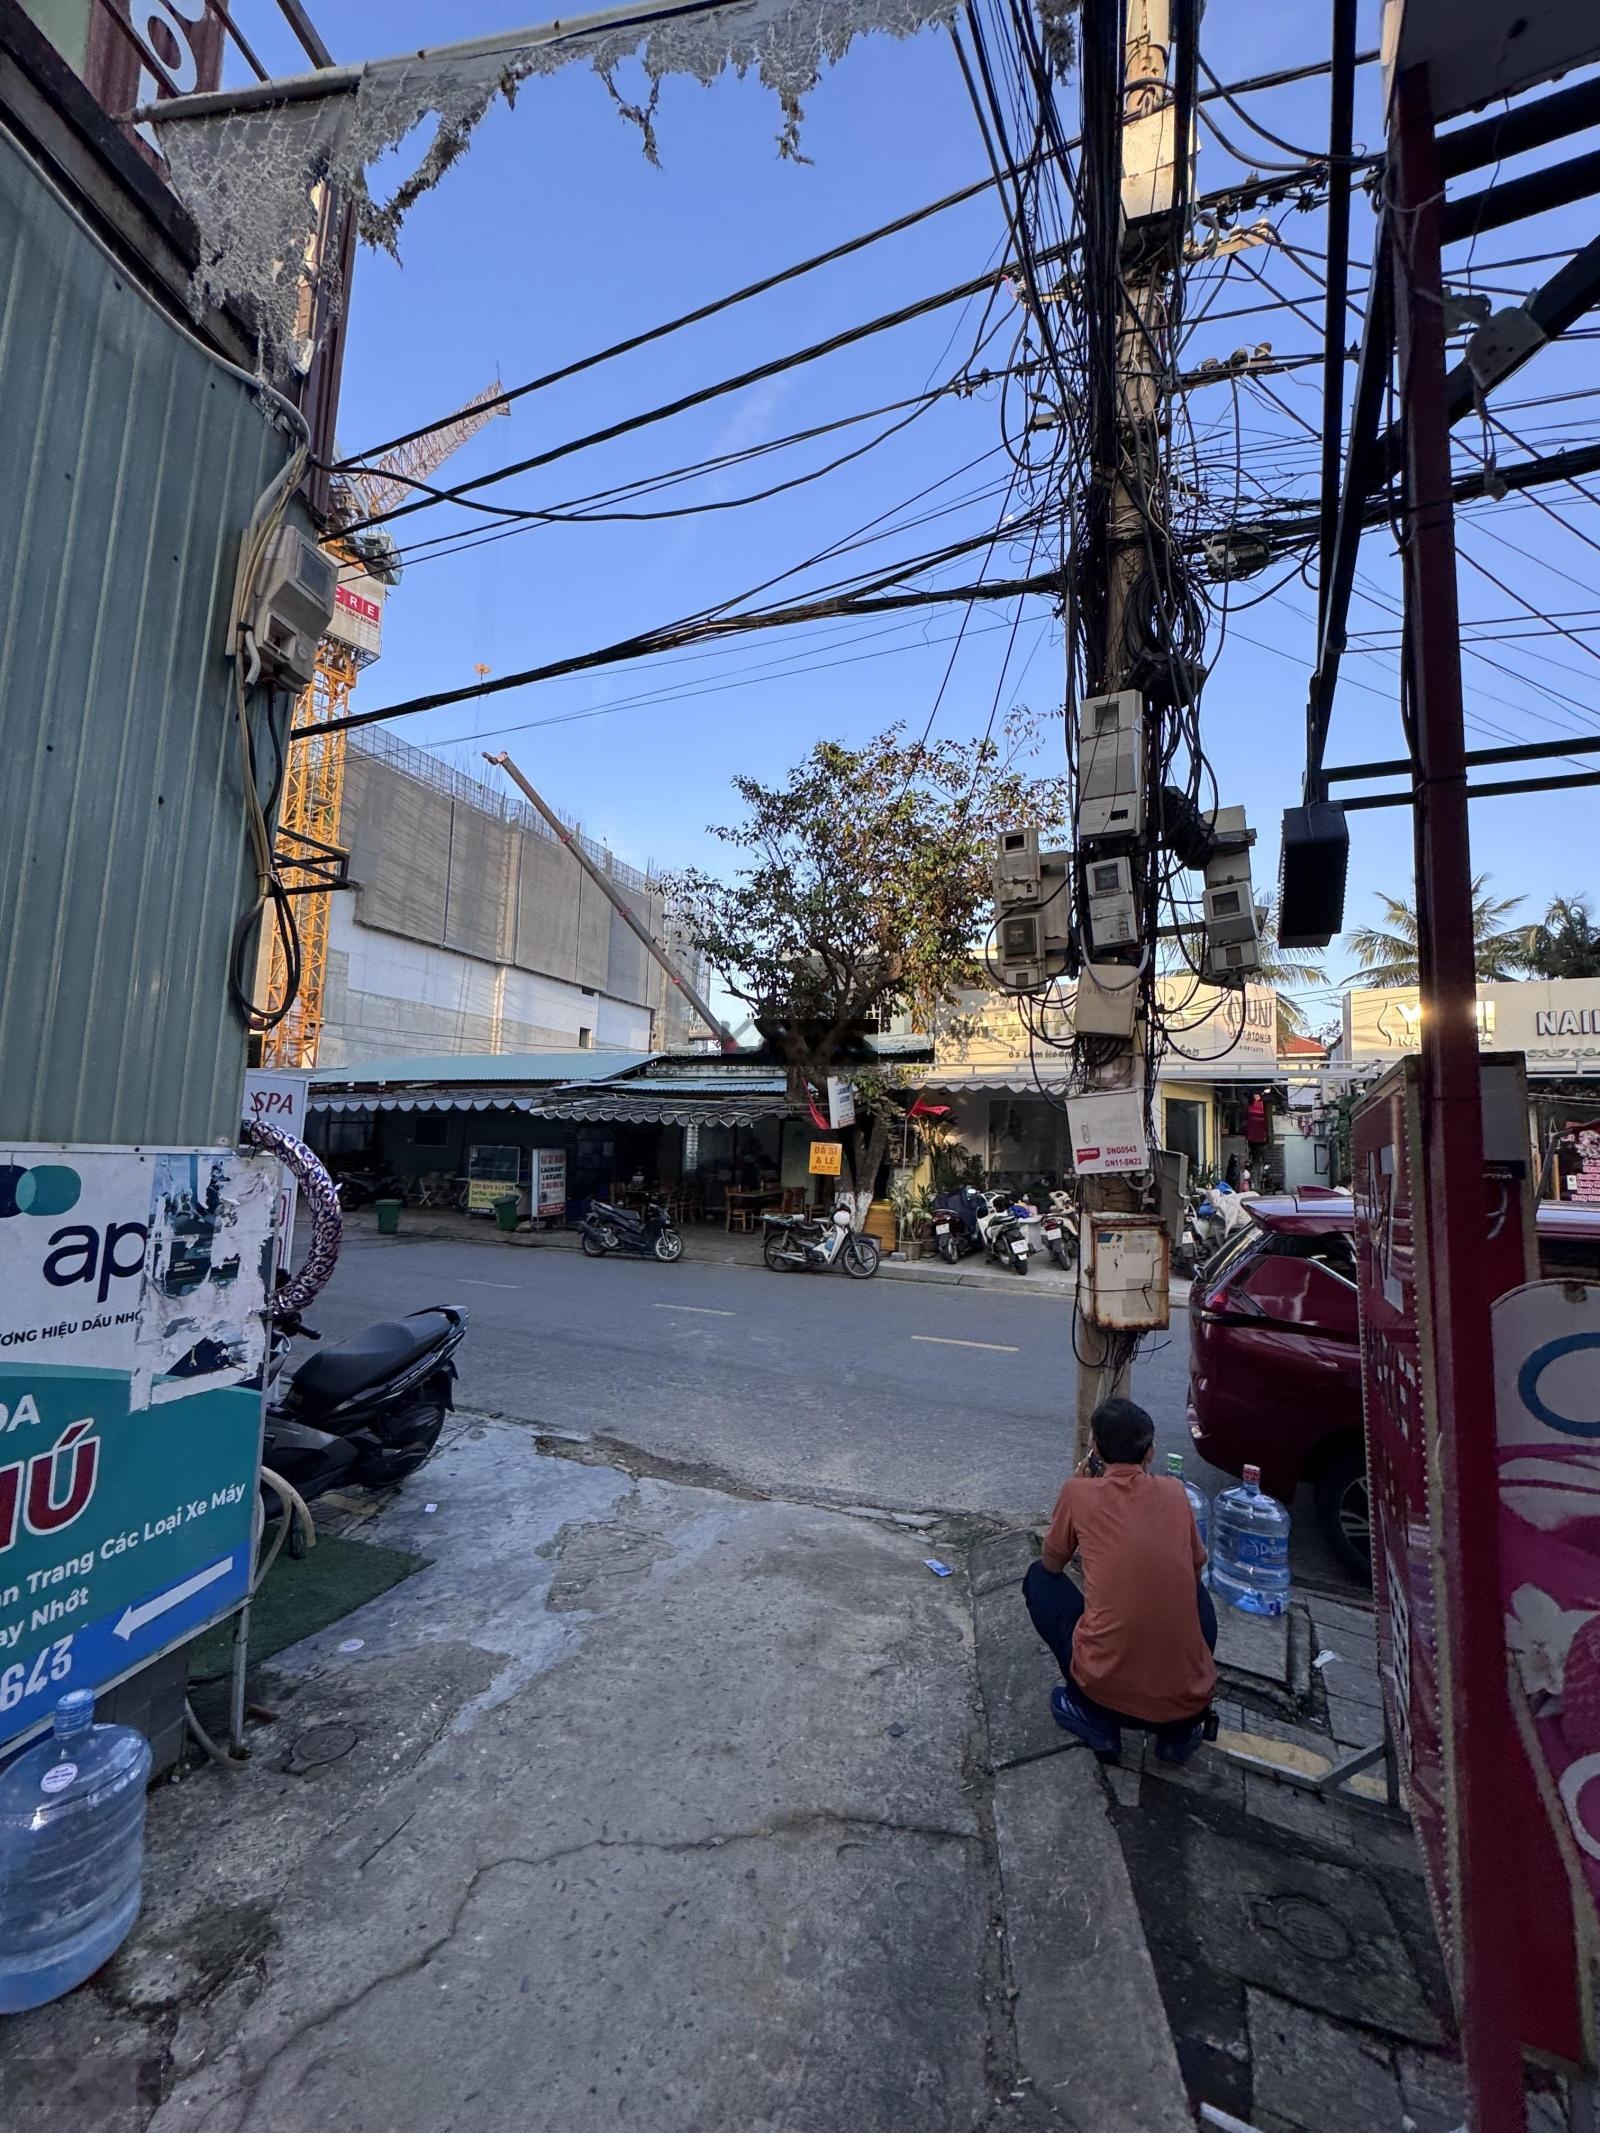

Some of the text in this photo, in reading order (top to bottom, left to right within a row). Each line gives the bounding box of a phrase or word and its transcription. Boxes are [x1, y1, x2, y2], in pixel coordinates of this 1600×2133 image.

[251, 1090, 294, 1116] SPA
[42, 1321, 78, 1339] HIỆU
[0, 1483, 246, 1608] n Trang Các Loại Xe Máy
[31, 1585, 89, 1632] Nhớt
